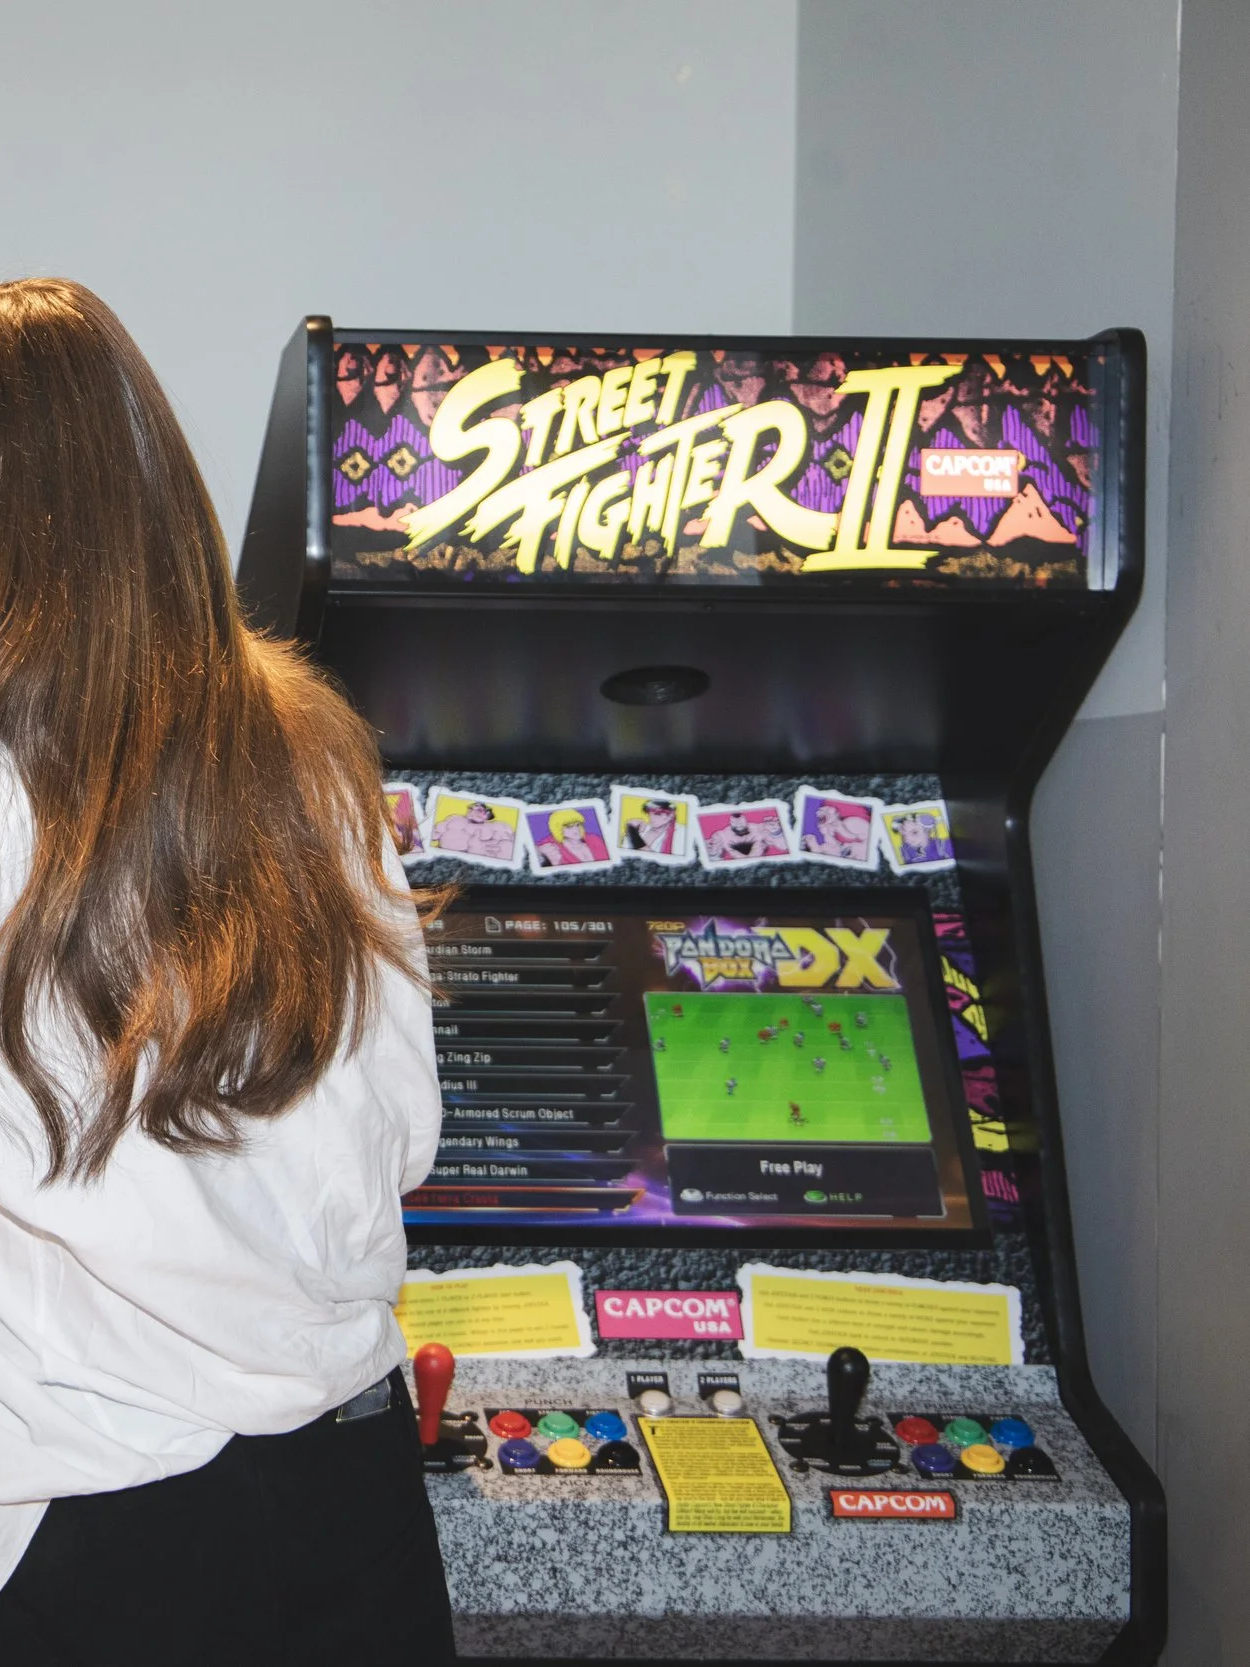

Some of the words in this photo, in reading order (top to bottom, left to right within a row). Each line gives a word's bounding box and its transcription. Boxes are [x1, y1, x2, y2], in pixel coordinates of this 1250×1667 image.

[403, 350, 700, 551] STREET
[801, 364, 963, 572] II
[925, 454, 1017, 477] CAPCOM
[462, 400, 839, 575] FIGHTER
[983, 478, 1012, 492] USA
[505, 920, 547, 931] PAGE:
[461, 944, 493, 956] Storm
[654, 917, 798, 976] PANDORA
[751, 927, 902, 988] DX
[446, 971, 479, 982] Strato
[482, 971, 519, 984] Fighter
[699, 957, 758, 991] BOX
[447, 1052, 471, 1064] Zing
[474, 1052, 492, 1064] Zip
[502, 1108, 536, 1119] Scrum
[538, 1108, 574, 1121] Object
[485, 1137, 519, 1150] Wings
[431, 1165, 460, 1176] Super
[463, 1165, 487, 1176] Real
[490, 1165, 528, 1176] Darwin
[760, 1160, 790, 1173] Free
[793, 1160, 823, 1178] Play
[706, 1191, 747, 1201] Function
[748, 1191, 779, 1201] Select
[603, 1297, 734, 1319] CAPCOM
[693, 1321, 732, 1334] USA
[636, 1375, 664, 1383] PLAYER
[525, 1398, 573, 1406] PUNCH
[559, 1479, 594, 1487] KICK
[975, 1484, 1011, 1492] KICK
[837, 1494, 947, 1513] CAPCOM
